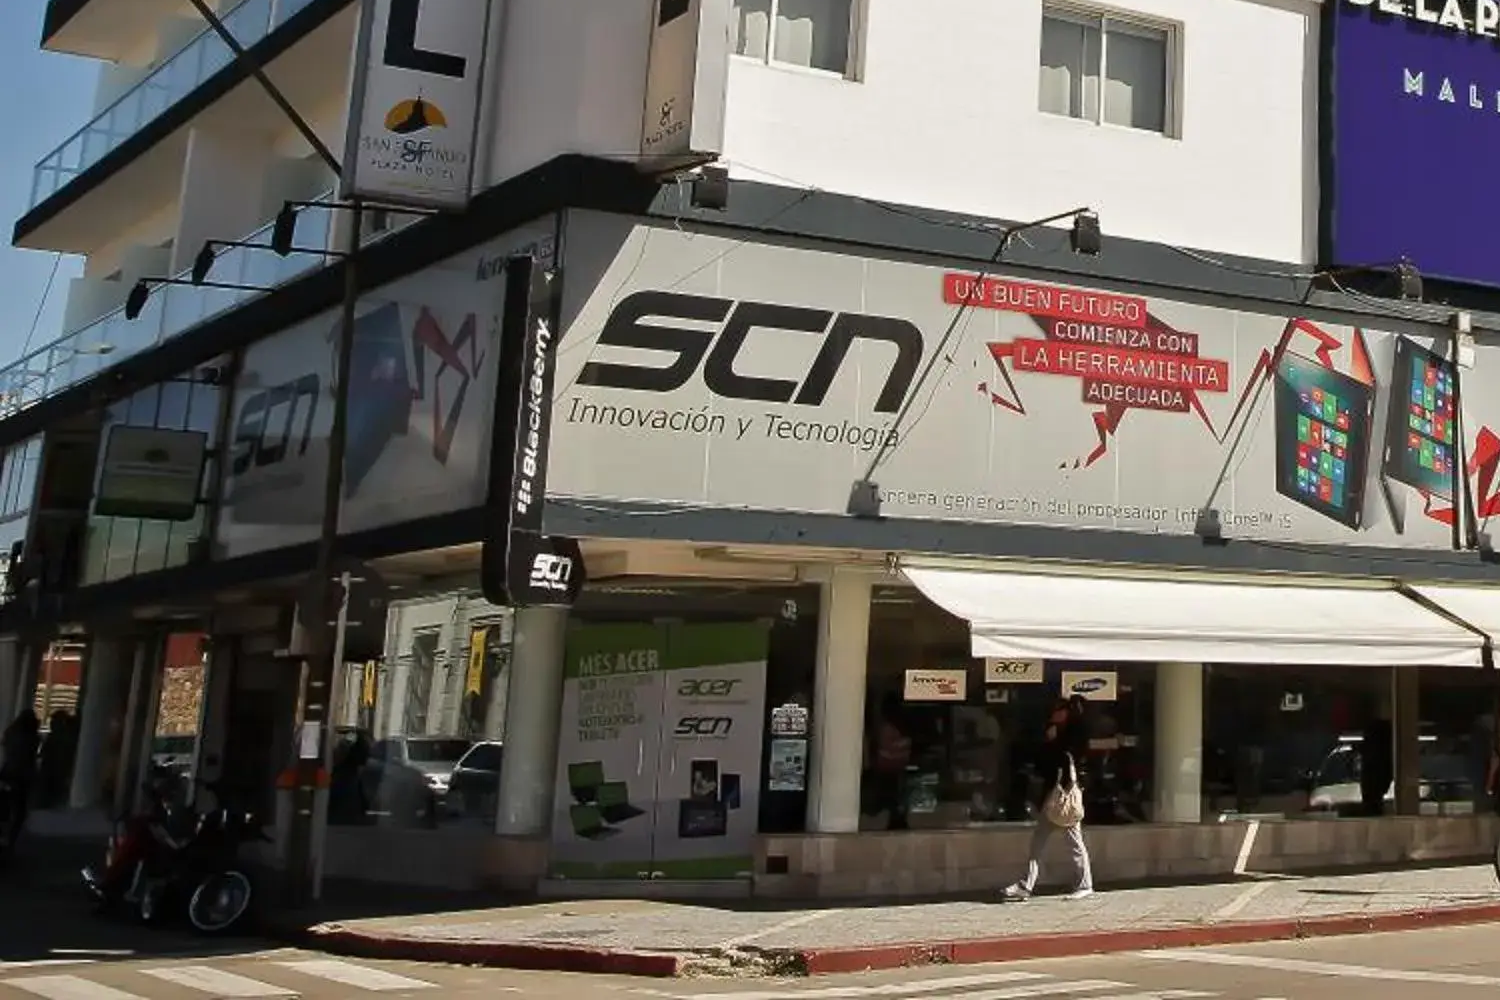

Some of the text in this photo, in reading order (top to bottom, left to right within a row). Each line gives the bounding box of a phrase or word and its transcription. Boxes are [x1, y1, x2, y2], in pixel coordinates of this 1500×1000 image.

[954, 279, 1140, 320] UN BUEN FUTURO
[1055, 321, 1193, 353] COMIENZA CON
[1020, 346, 1219, 386] LA HERRAMIENTA
[522, 317, 551, 478] BlackBerry
[1087, 382, 1185, 407] ADECUADA
[566, 398, 901, 451] Innovación y Tecnología
[1077, 500, 1168, 524] procesador
[995, 661, 1034, 674] acer
[678, 679, 742, 696] acer
